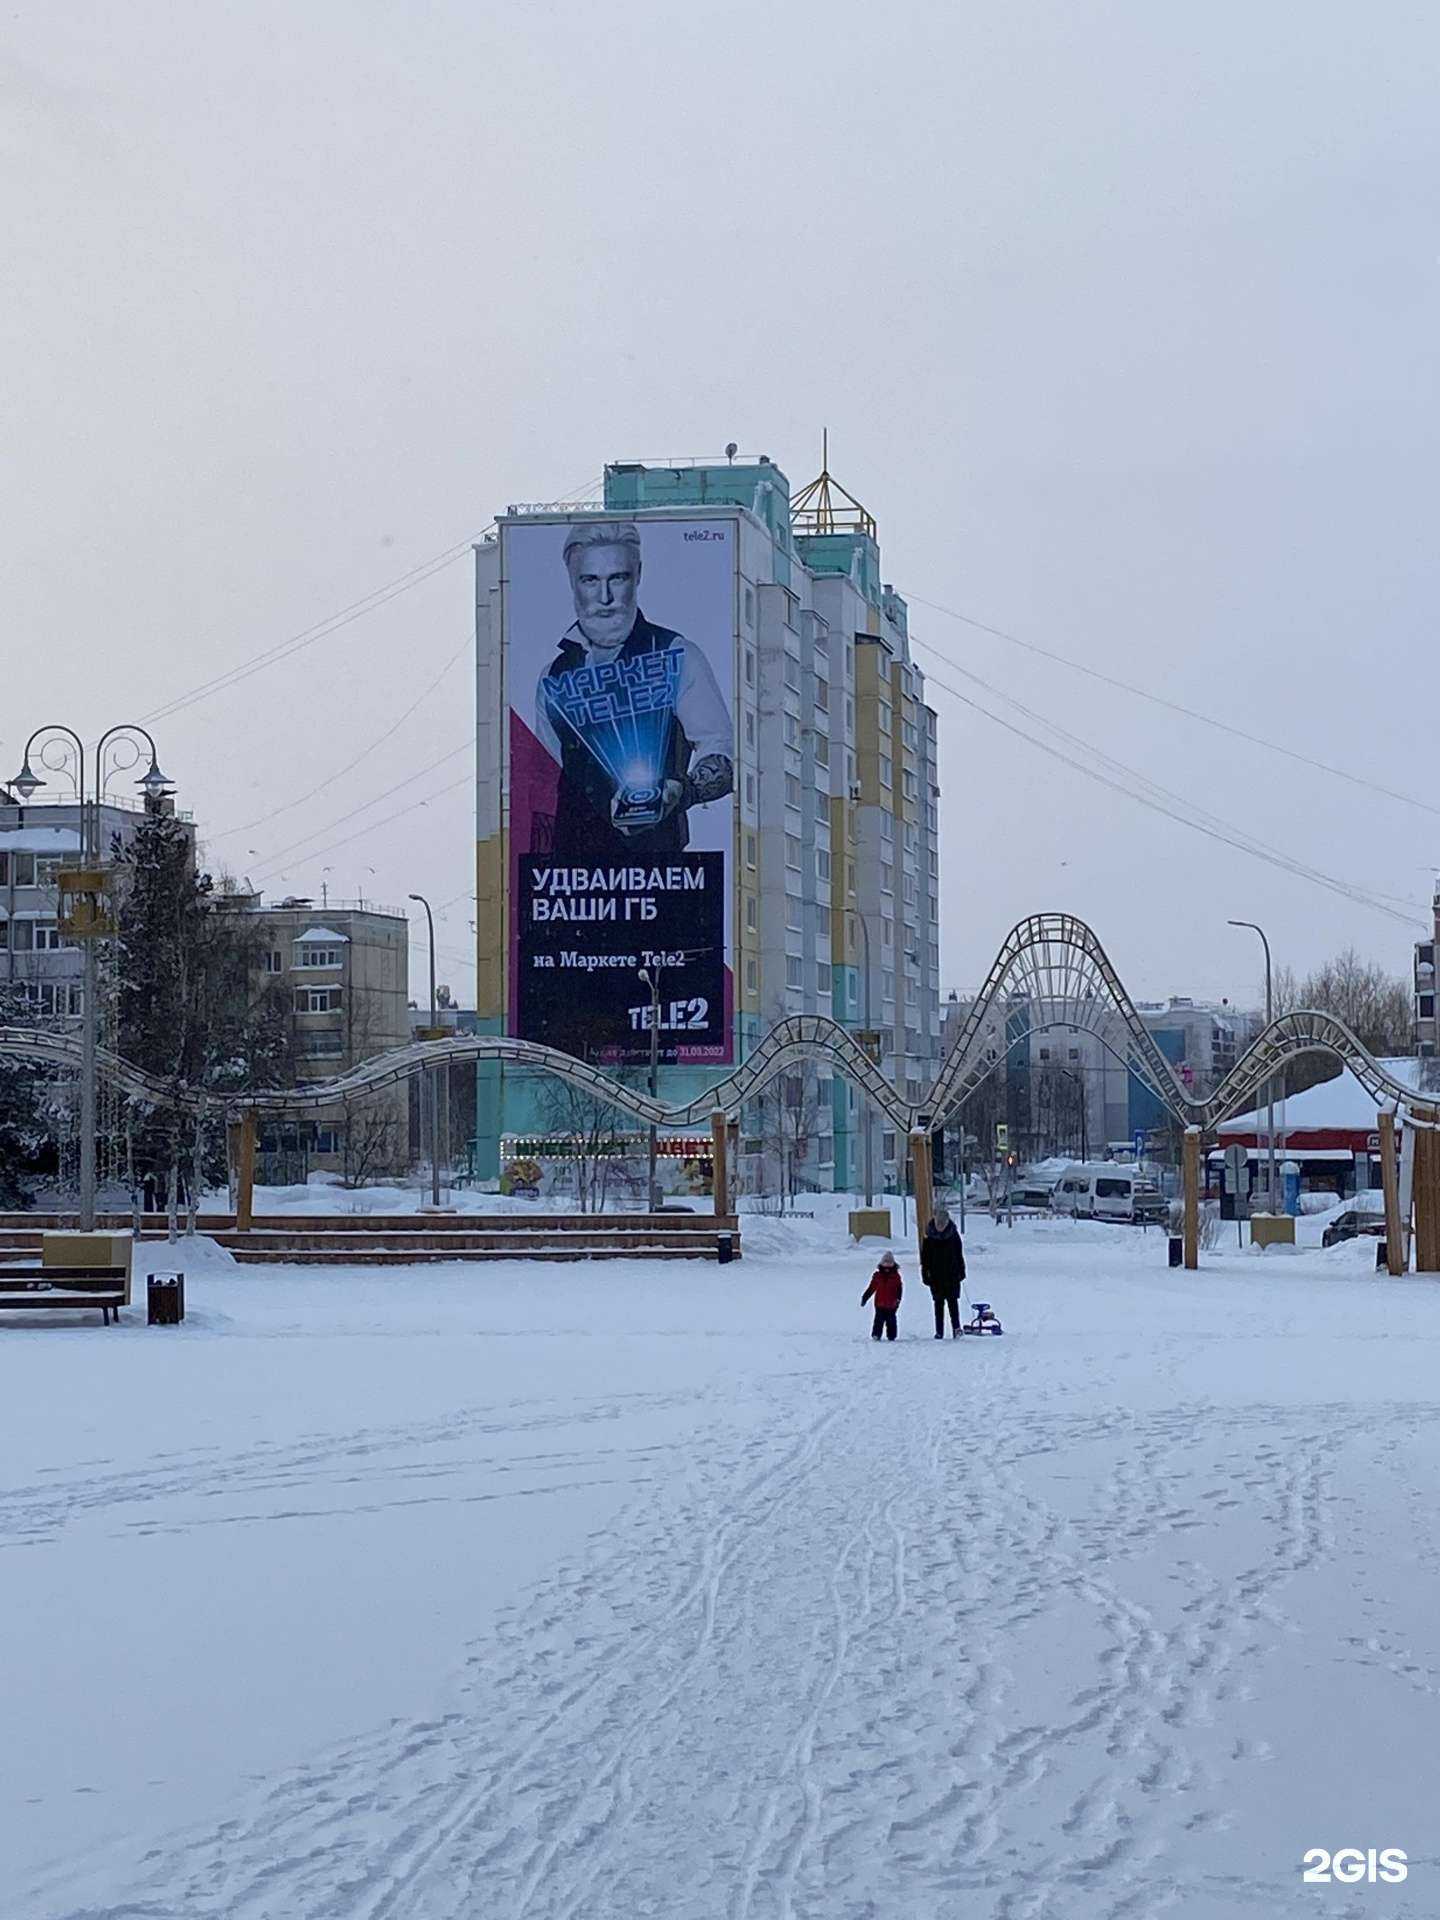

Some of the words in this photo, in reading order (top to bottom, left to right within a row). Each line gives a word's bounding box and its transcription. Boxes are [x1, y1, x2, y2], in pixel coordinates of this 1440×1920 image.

[683, 530, 725, 542] tele2.ru
[541, 647, 685, 697] МАРКЕТ
[564, 682, 674, 727] TELE2
[531, 867, 705, 895] УДВАИВАЕМ
[532, 898, 617, 921] ВАШИ
[624, 898, 658, 921] ГБ
[533, 954, 555, 968] на
[560, 951, 637, 971] Маркете
[641, 950, 686, 968] Tele2
[628, 996, 710, 1031] TELE2
